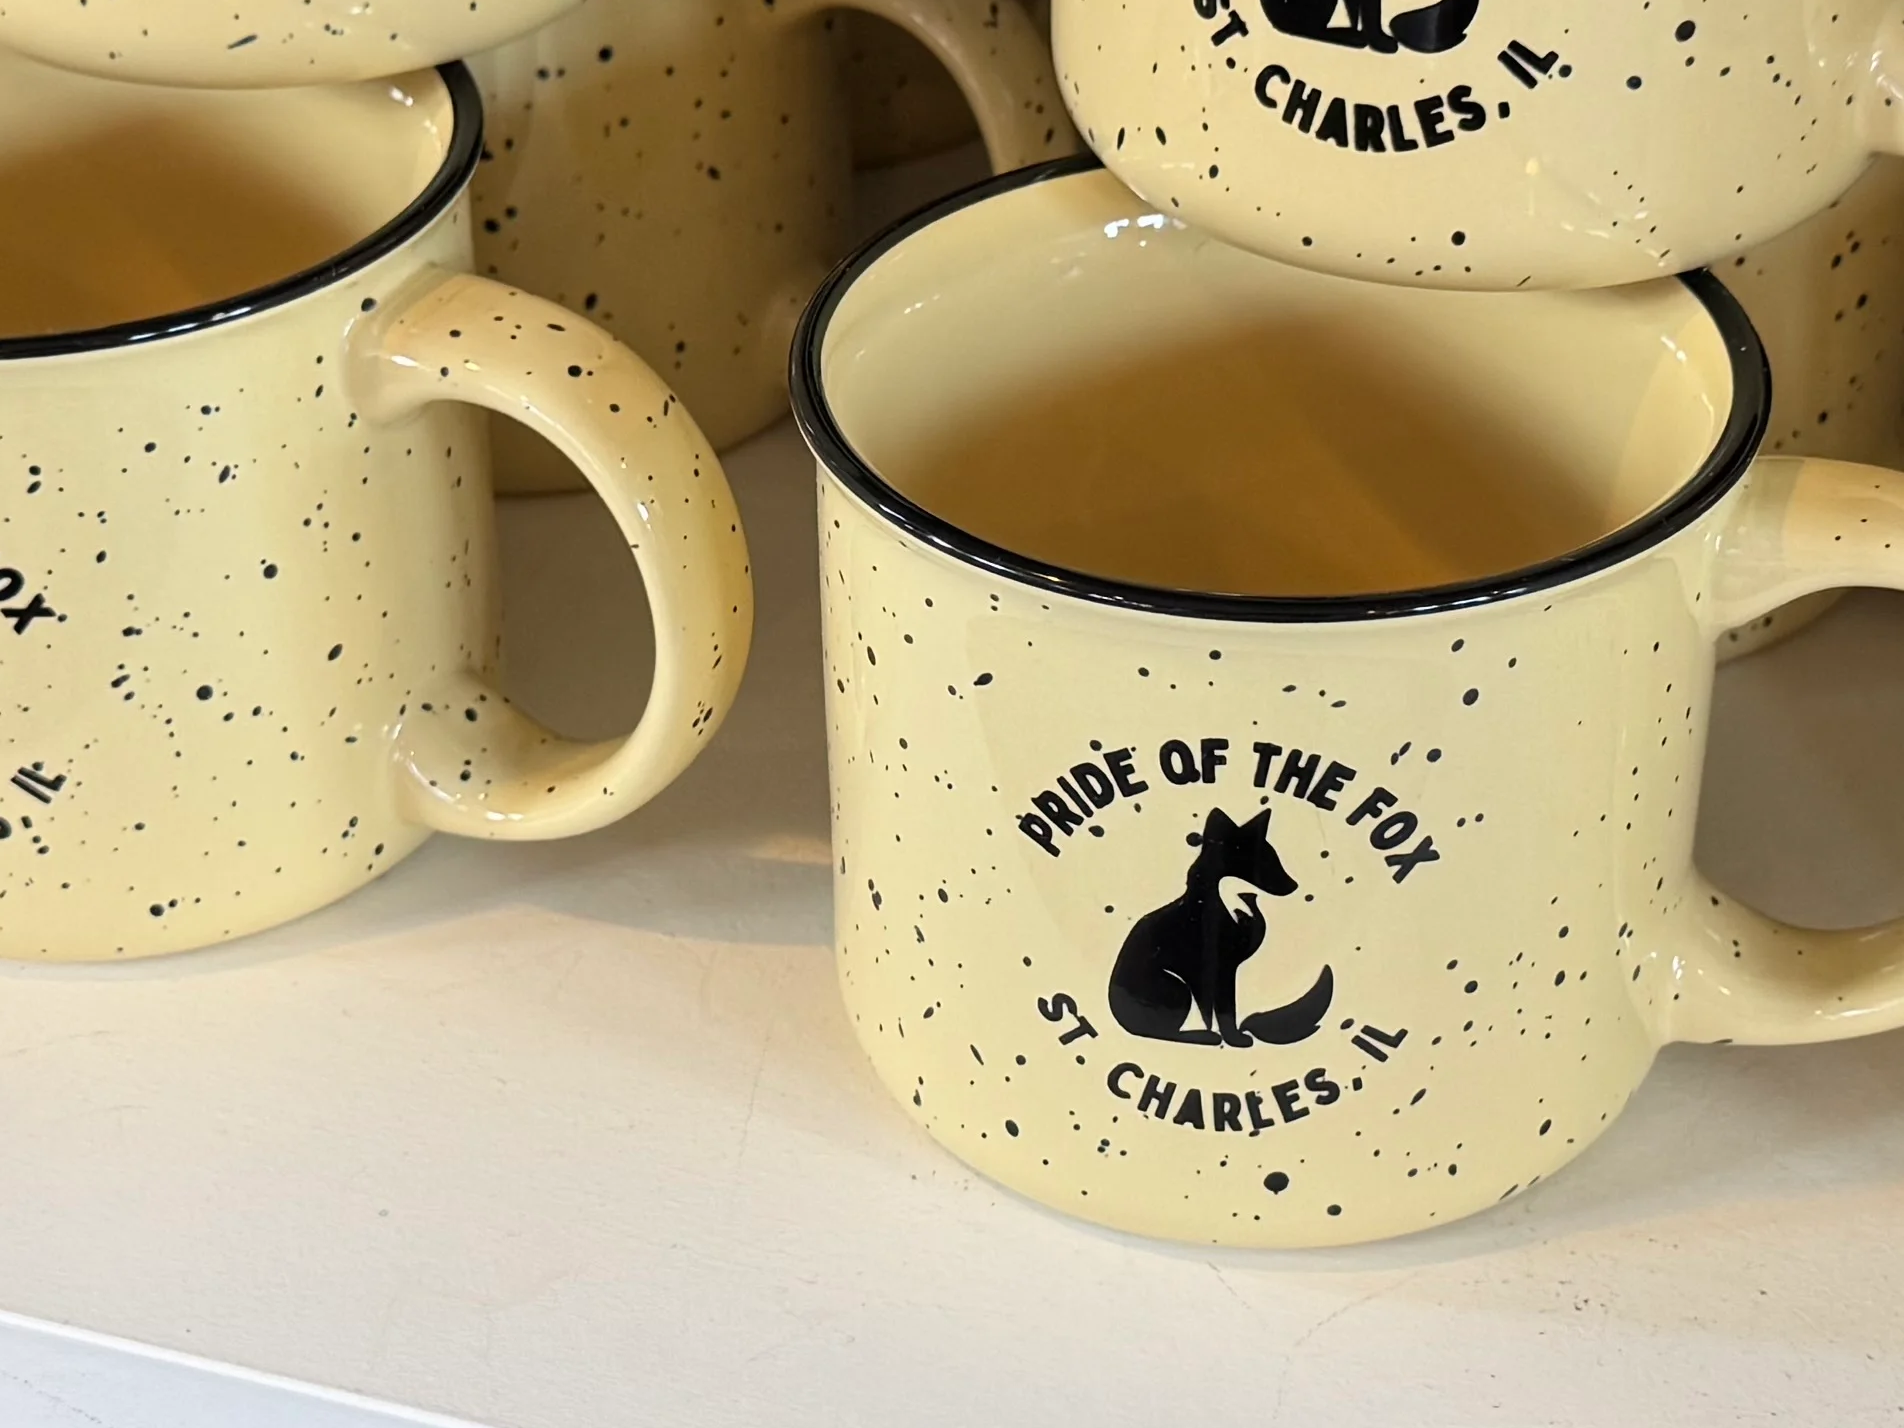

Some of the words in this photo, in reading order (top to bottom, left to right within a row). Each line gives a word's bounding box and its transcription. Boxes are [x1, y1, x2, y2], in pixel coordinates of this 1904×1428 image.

[1498, 39, 1559, 90] IL
[10, 765, 68, 804] IL
[1018, 748, 1149, 858] PRIDE
[1159, 738, 1229, 785] OF
[1252, 741, 1357, 811] THE
[1345, 787, 1440, 884] FOX
[1351, 1024, 1409, 1063] IL
